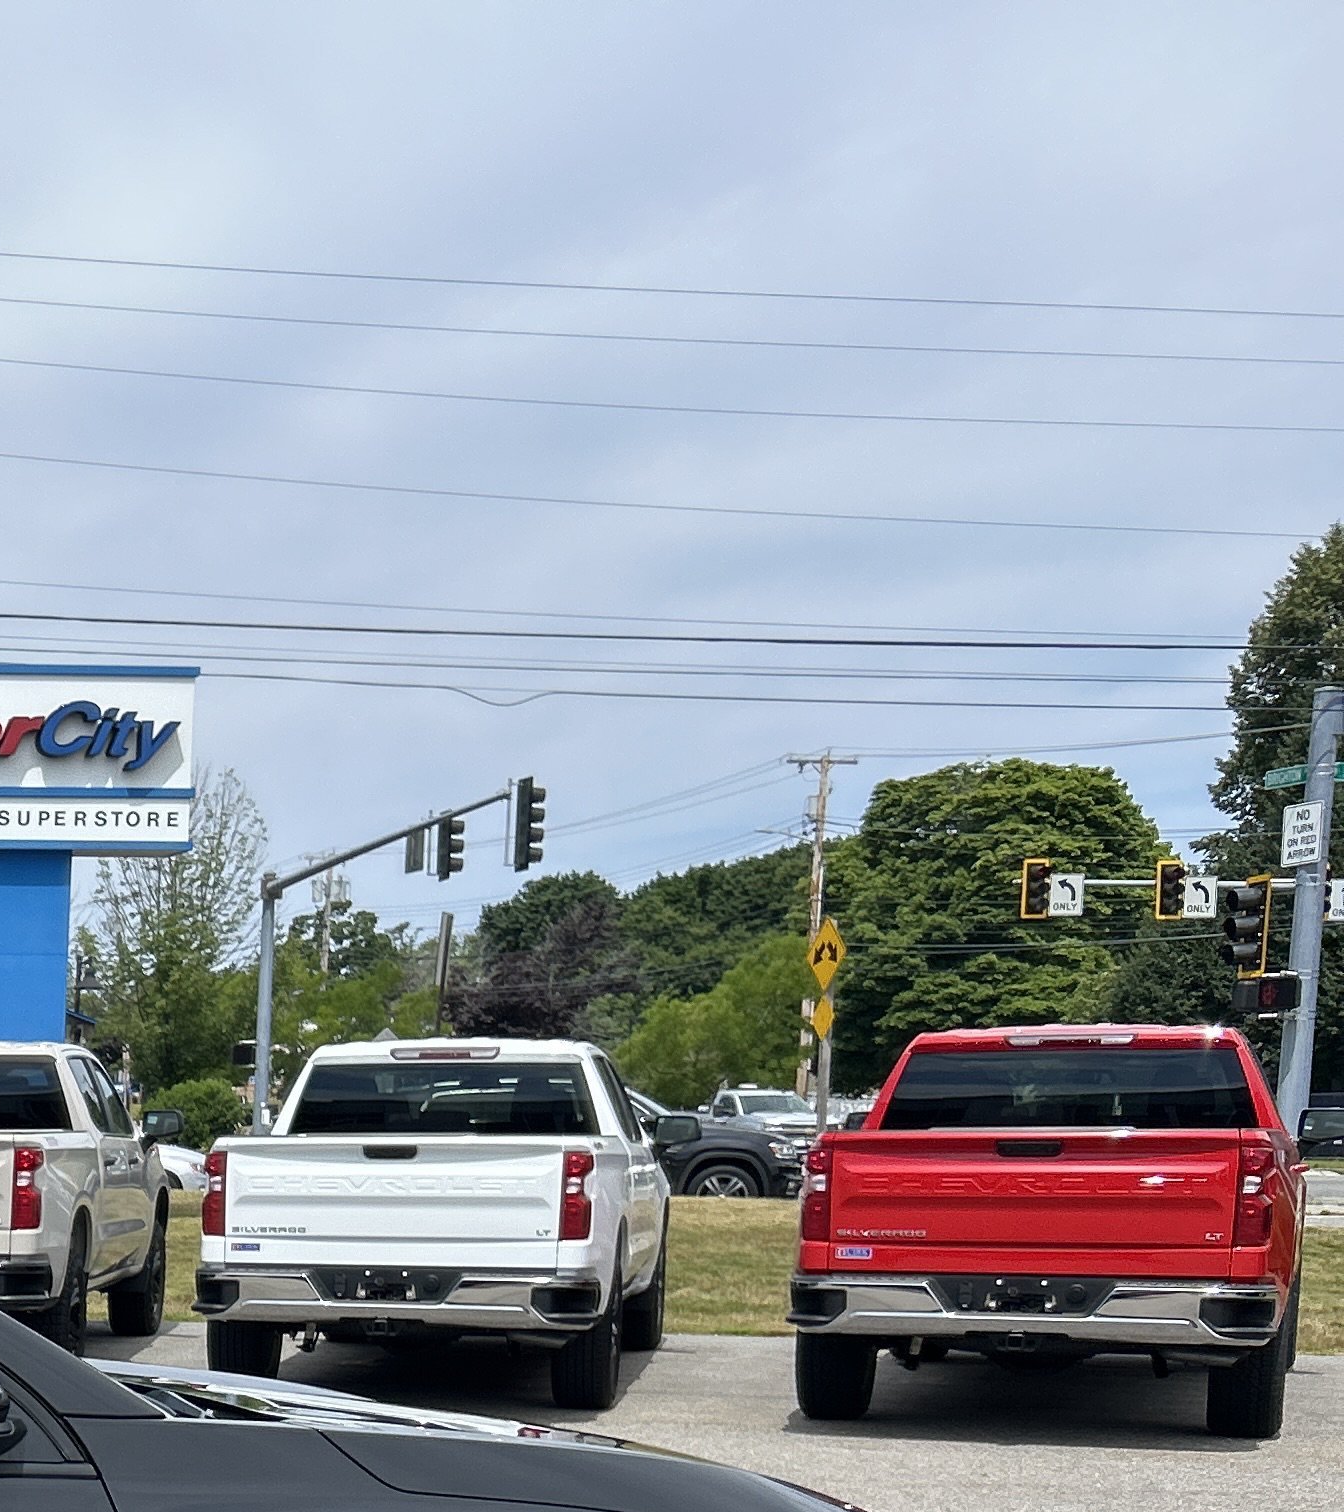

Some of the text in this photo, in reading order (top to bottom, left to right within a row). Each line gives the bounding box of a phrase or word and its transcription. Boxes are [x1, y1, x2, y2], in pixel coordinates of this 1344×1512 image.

[1296, 809, 1310, 821] NO
[1292, 823, 1314, 835] TURN
[1052, 902, 1078, 911] ONLY
[1186, 904, 1211, 914] ONLY
[1332, 908, 1344, 917] ON
[248, 1175, 538, 1194] CHEVROLET
[857, 1176, 1209, 1194] CHEVROLET
[231, 1225, 307, 1234] SILVERADO
[536, 1228, 551, 1238] LT
[835, 1228, 927, 1239] SILVERADO
[1204, 1230, 1224, 1241] LT
